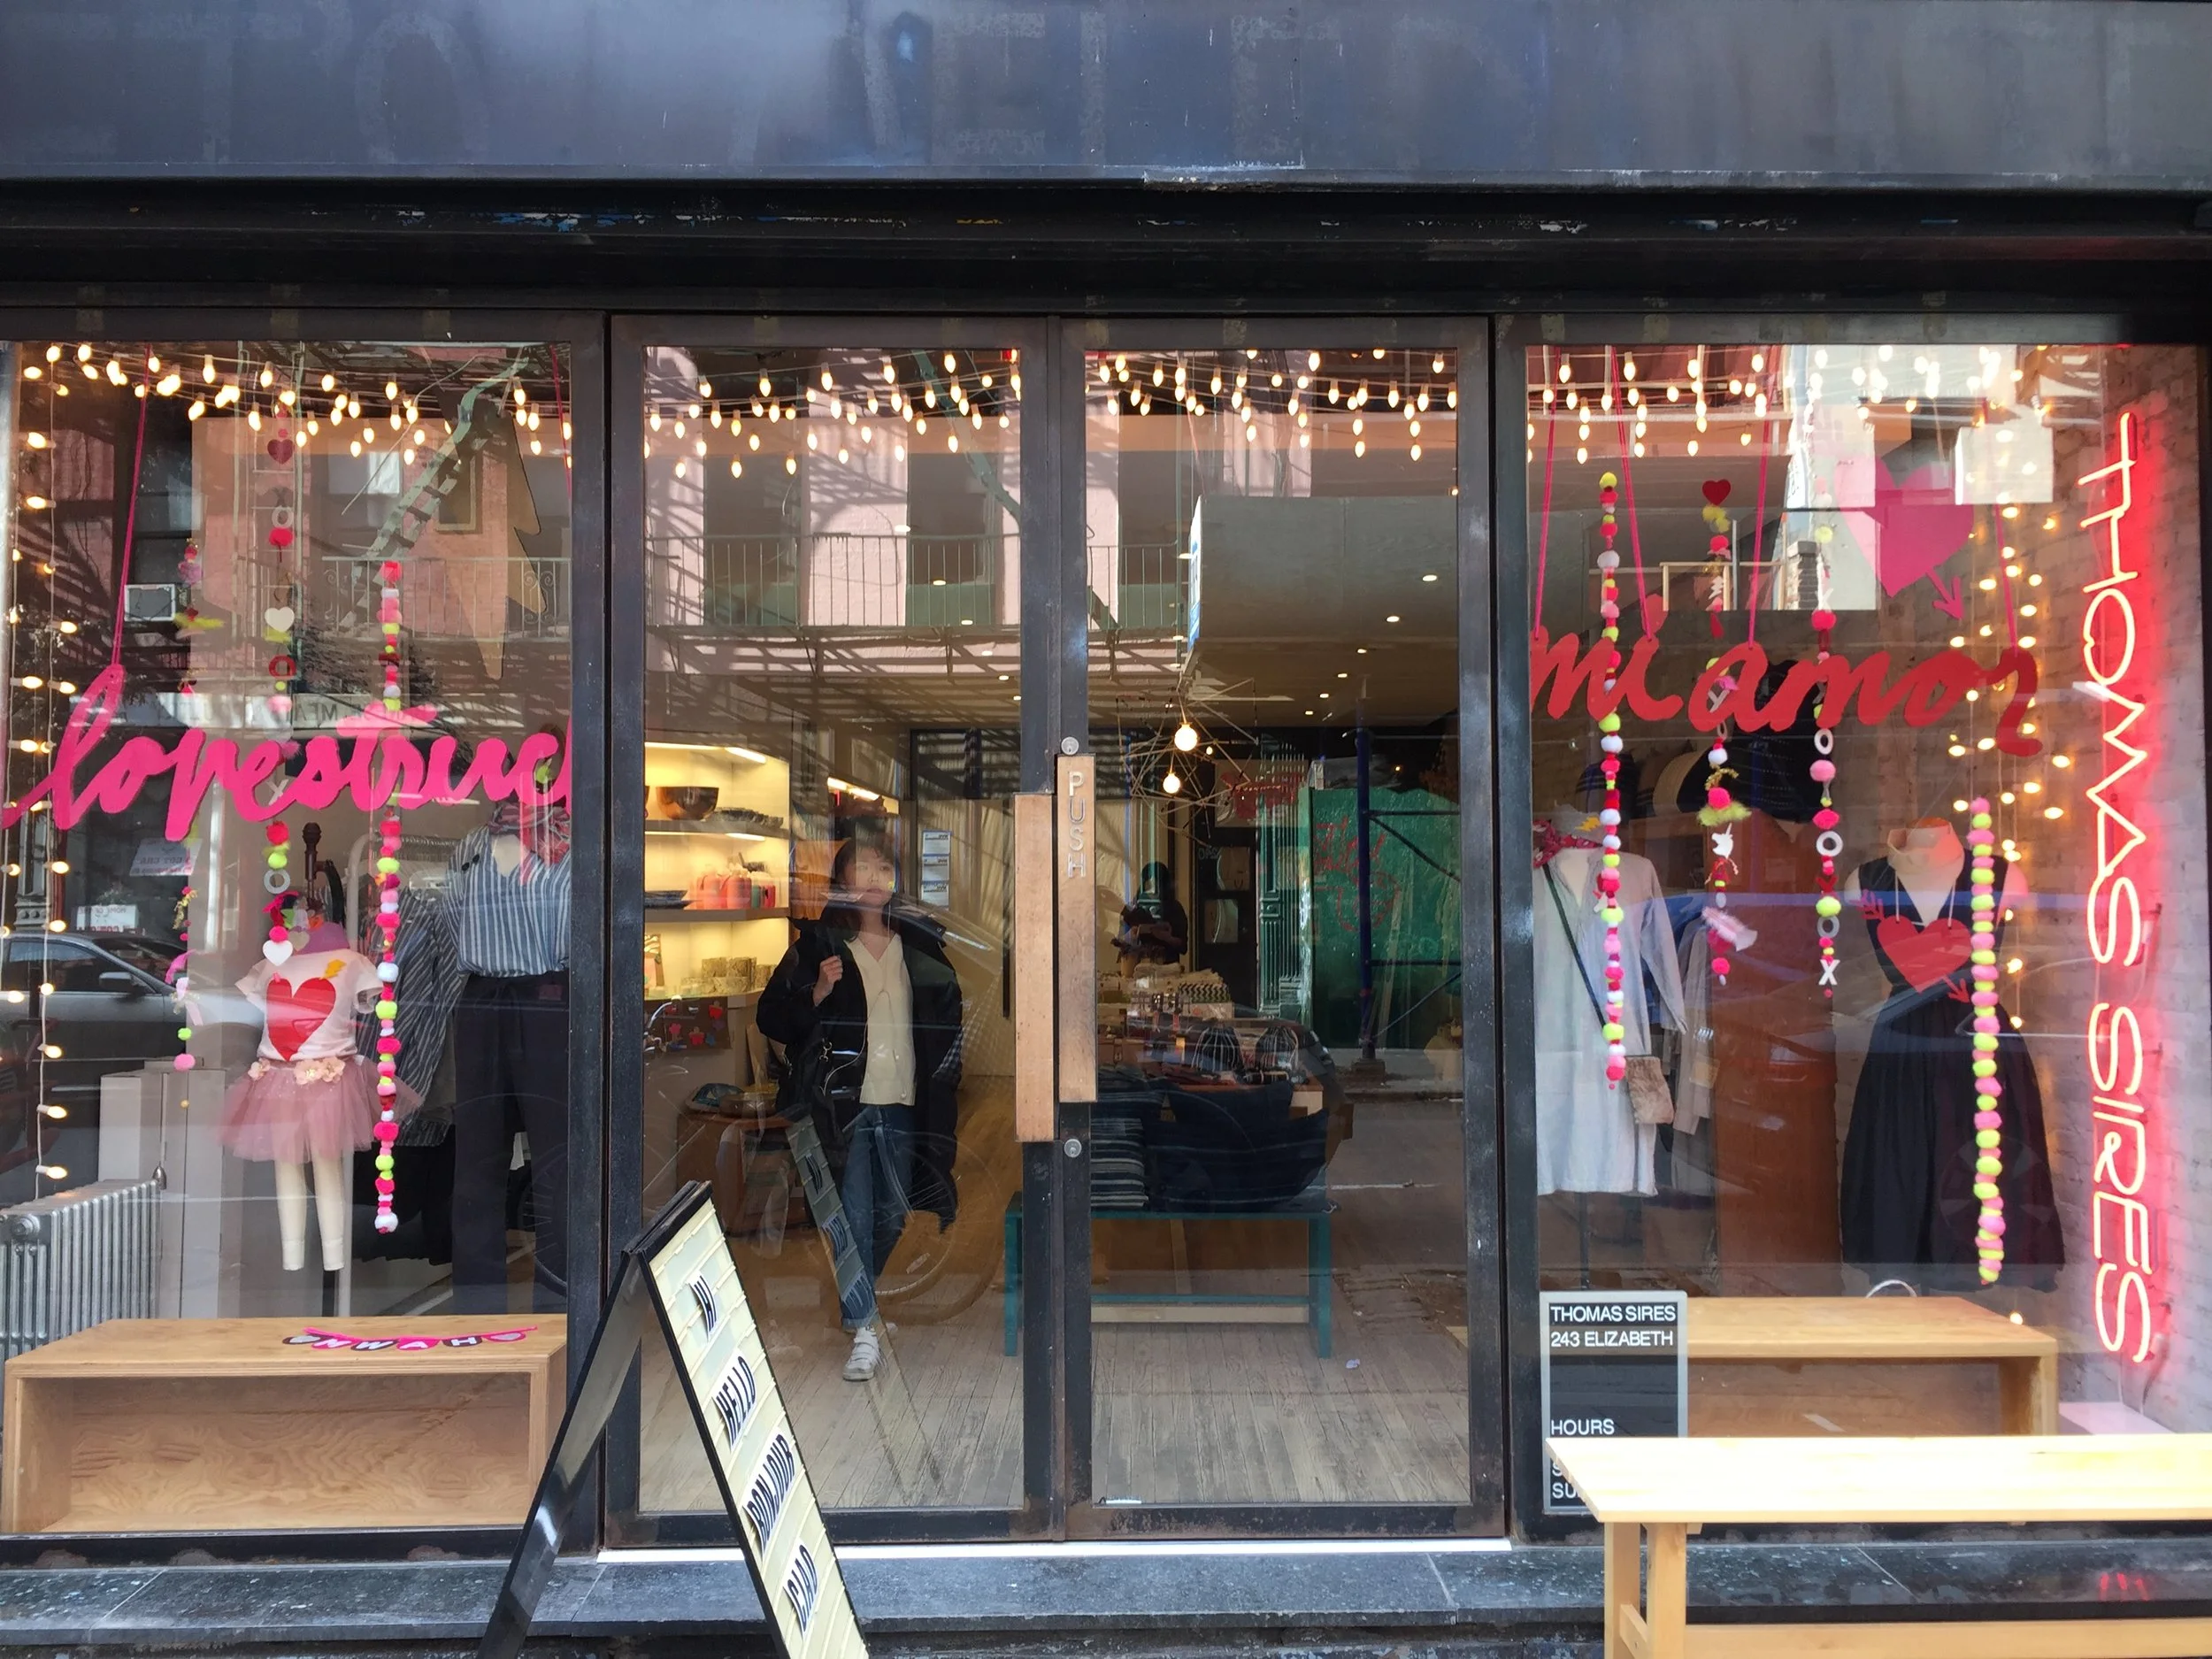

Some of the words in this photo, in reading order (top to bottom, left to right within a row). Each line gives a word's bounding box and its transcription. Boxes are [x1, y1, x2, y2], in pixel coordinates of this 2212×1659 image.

[2078, 411, 2147, 966] THOMAS
[0, 664, 572, 841] lovestruc
[1067, 770, 1087, 878] PUSH
[2088, 1002, 2153, 1363] SIRES
[1550, 1306, 1623, 1323] THOMAS
[1624, 1305, 1677, 1322] SIRES
[1550, 1331, 1580, 1348] 243
[1585, 1331, 1674, 1347] ELIZABETH
[716, 1356, 757, 1447] HELLO
[1551, 1418, 1615, 1435] HOURS
[747, 1433, 795, 1556] BONJOUR
[1552, 1482, 1578, 1499] SU
[787, 1544, 818, 1633] CIAO
